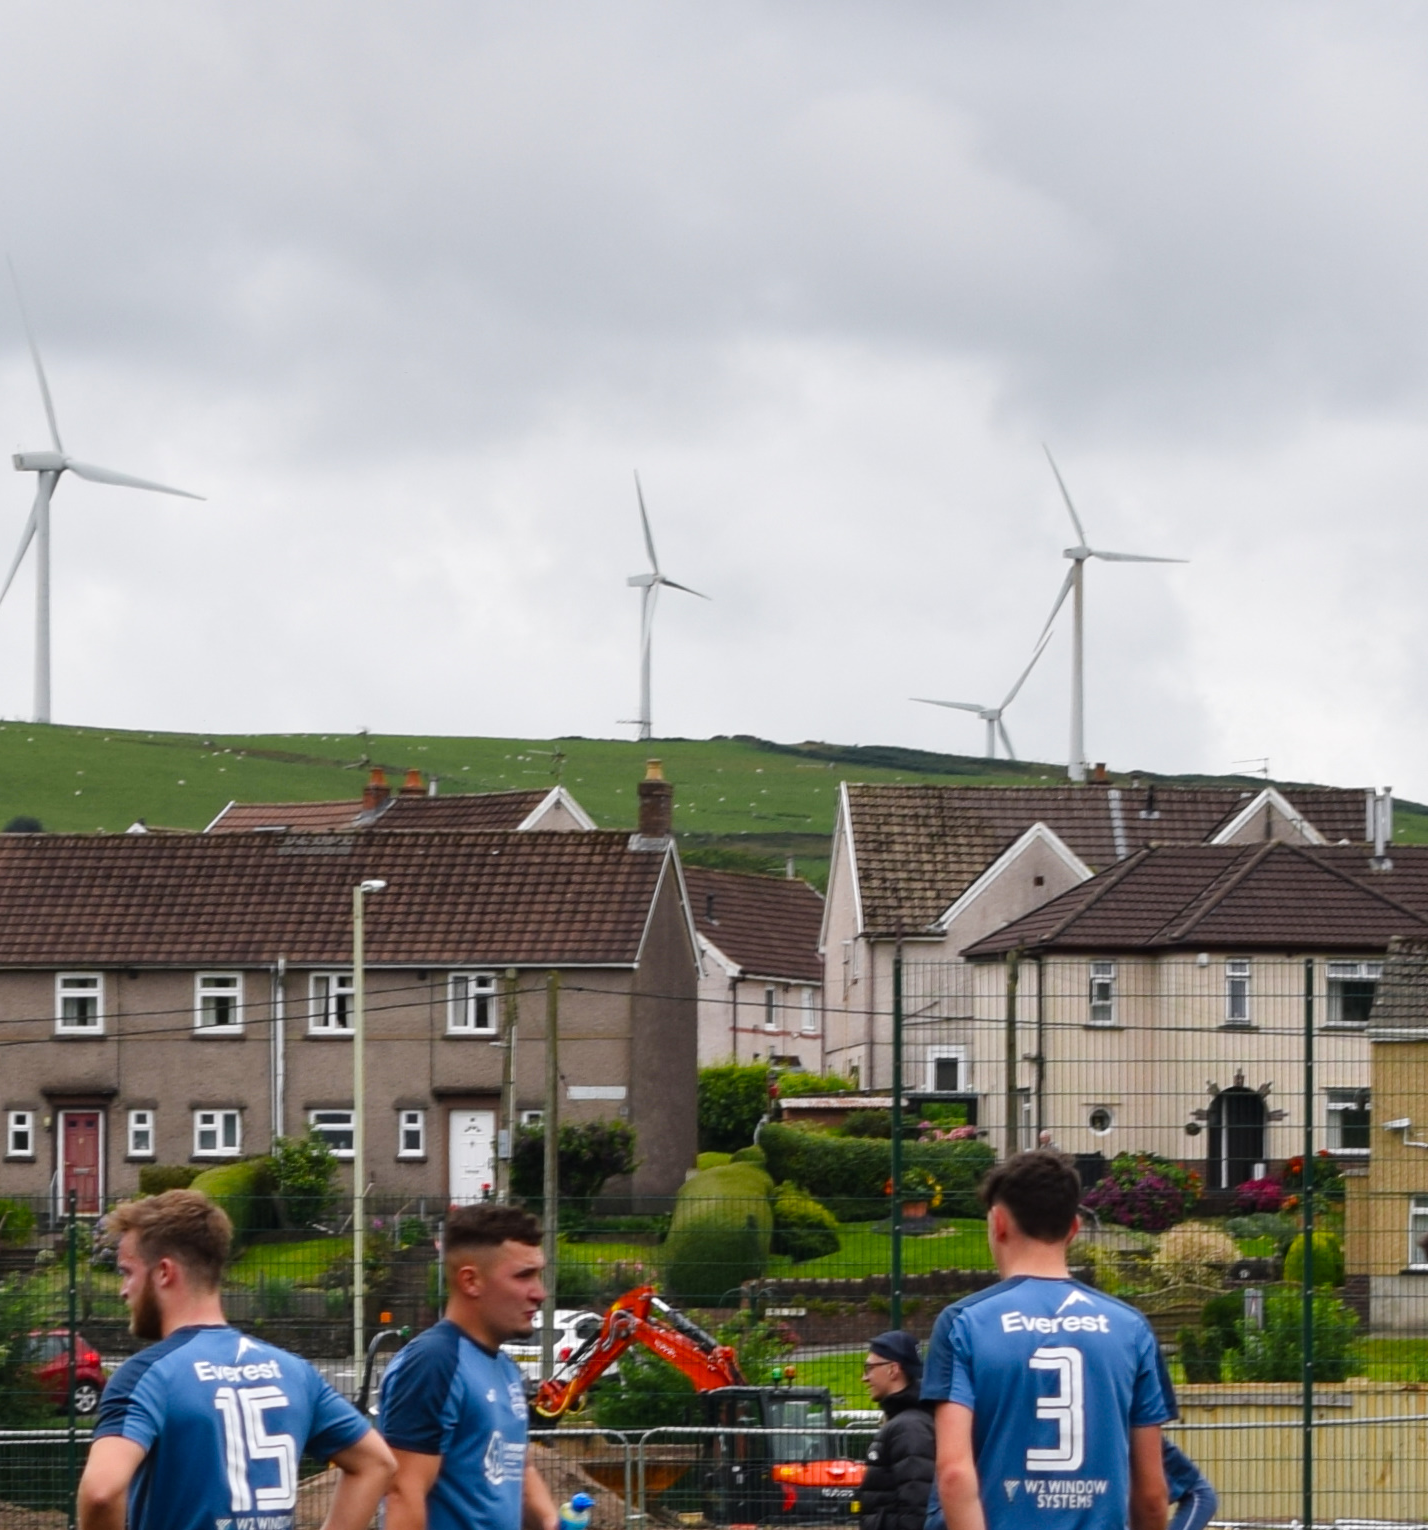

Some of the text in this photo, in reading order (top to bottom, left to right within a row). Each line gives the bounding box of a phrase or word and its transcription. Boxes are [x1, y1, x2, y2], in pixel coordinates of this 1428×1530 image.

[1001, 1311, 1110, 1333] Everest
[193, 1360, 283, 1382] Everest
[1026, 1347, 1084, 1471] 3
[214, 1387, 298, 1513] 15
[1024, 1480, 1108, 1494] W2 WINDOW
[1037, 1494, 1093, 1508] SYSTEMS
